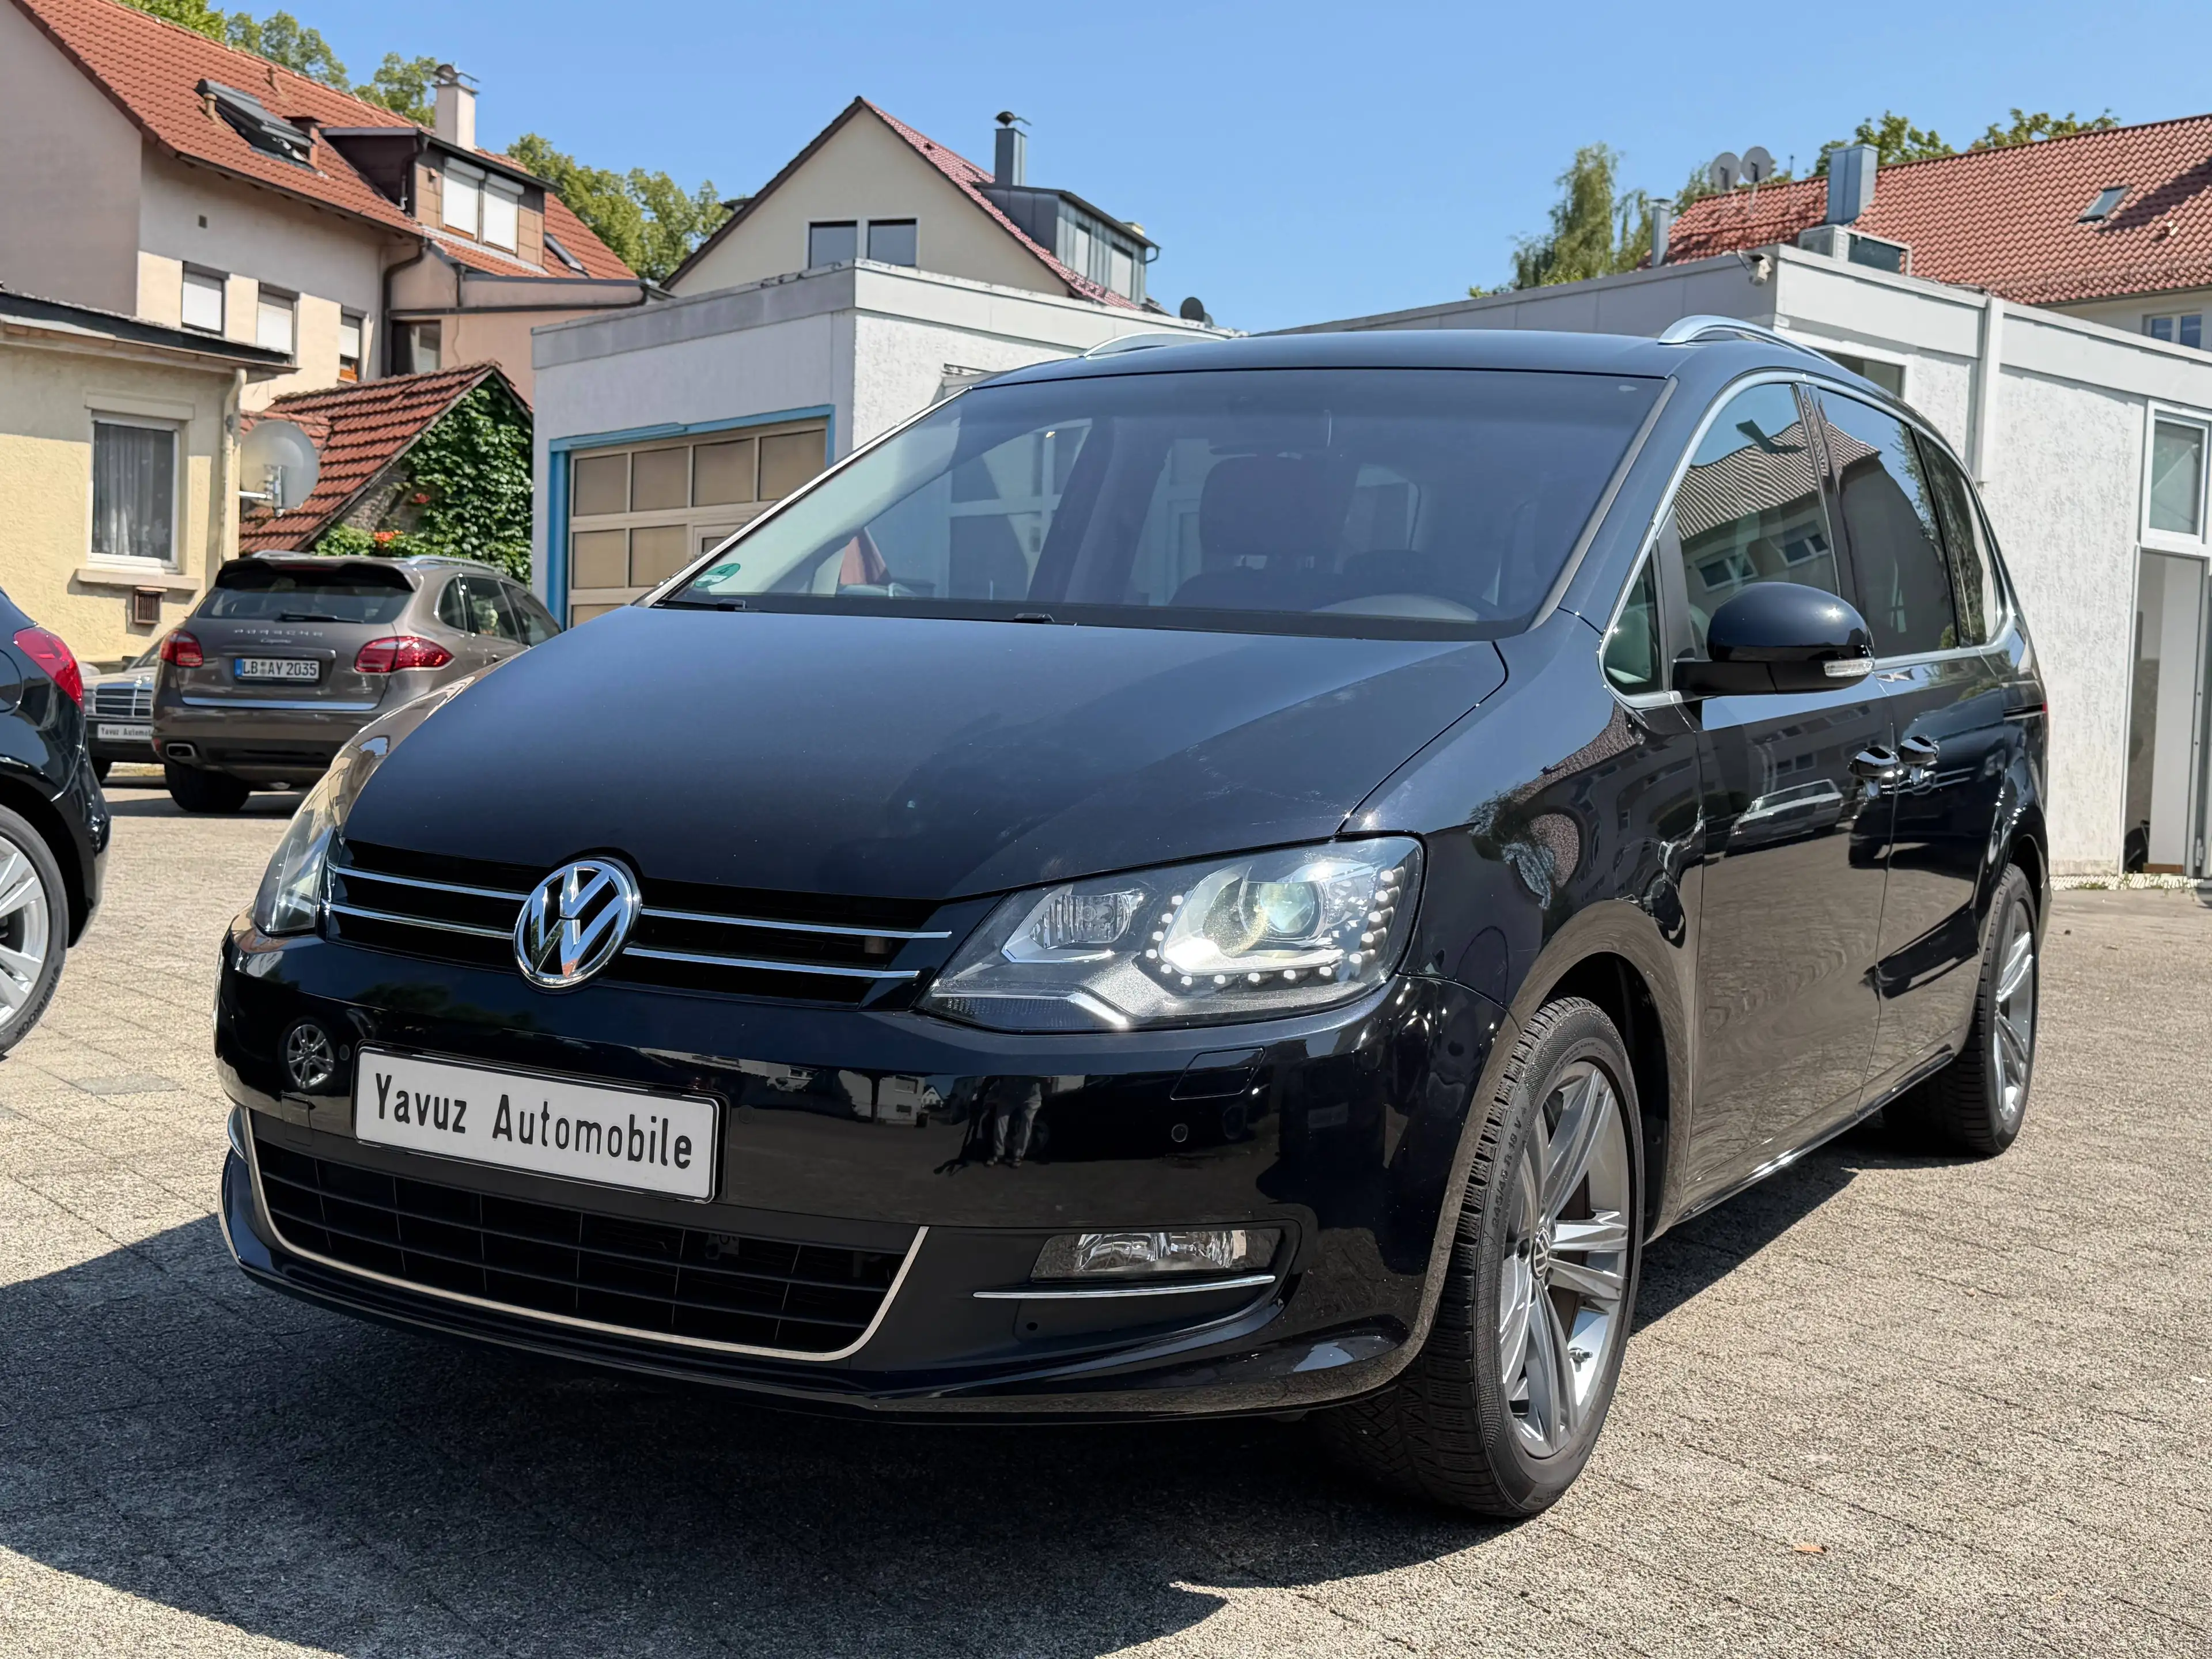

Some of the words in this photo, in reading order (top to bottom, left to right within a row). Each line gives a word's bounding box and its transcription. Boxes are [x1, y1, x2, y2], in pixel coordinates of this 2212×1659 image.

[243, 661, 258, 675] LB
[268, 661, 283, 675] AY
[286, 662, 317, 676] 2035
[101, 727, 119, 736] Yavuz
[376, 1073, 467, 1134] Yavuz
[492, 1094, 692, 1169] Automobile
